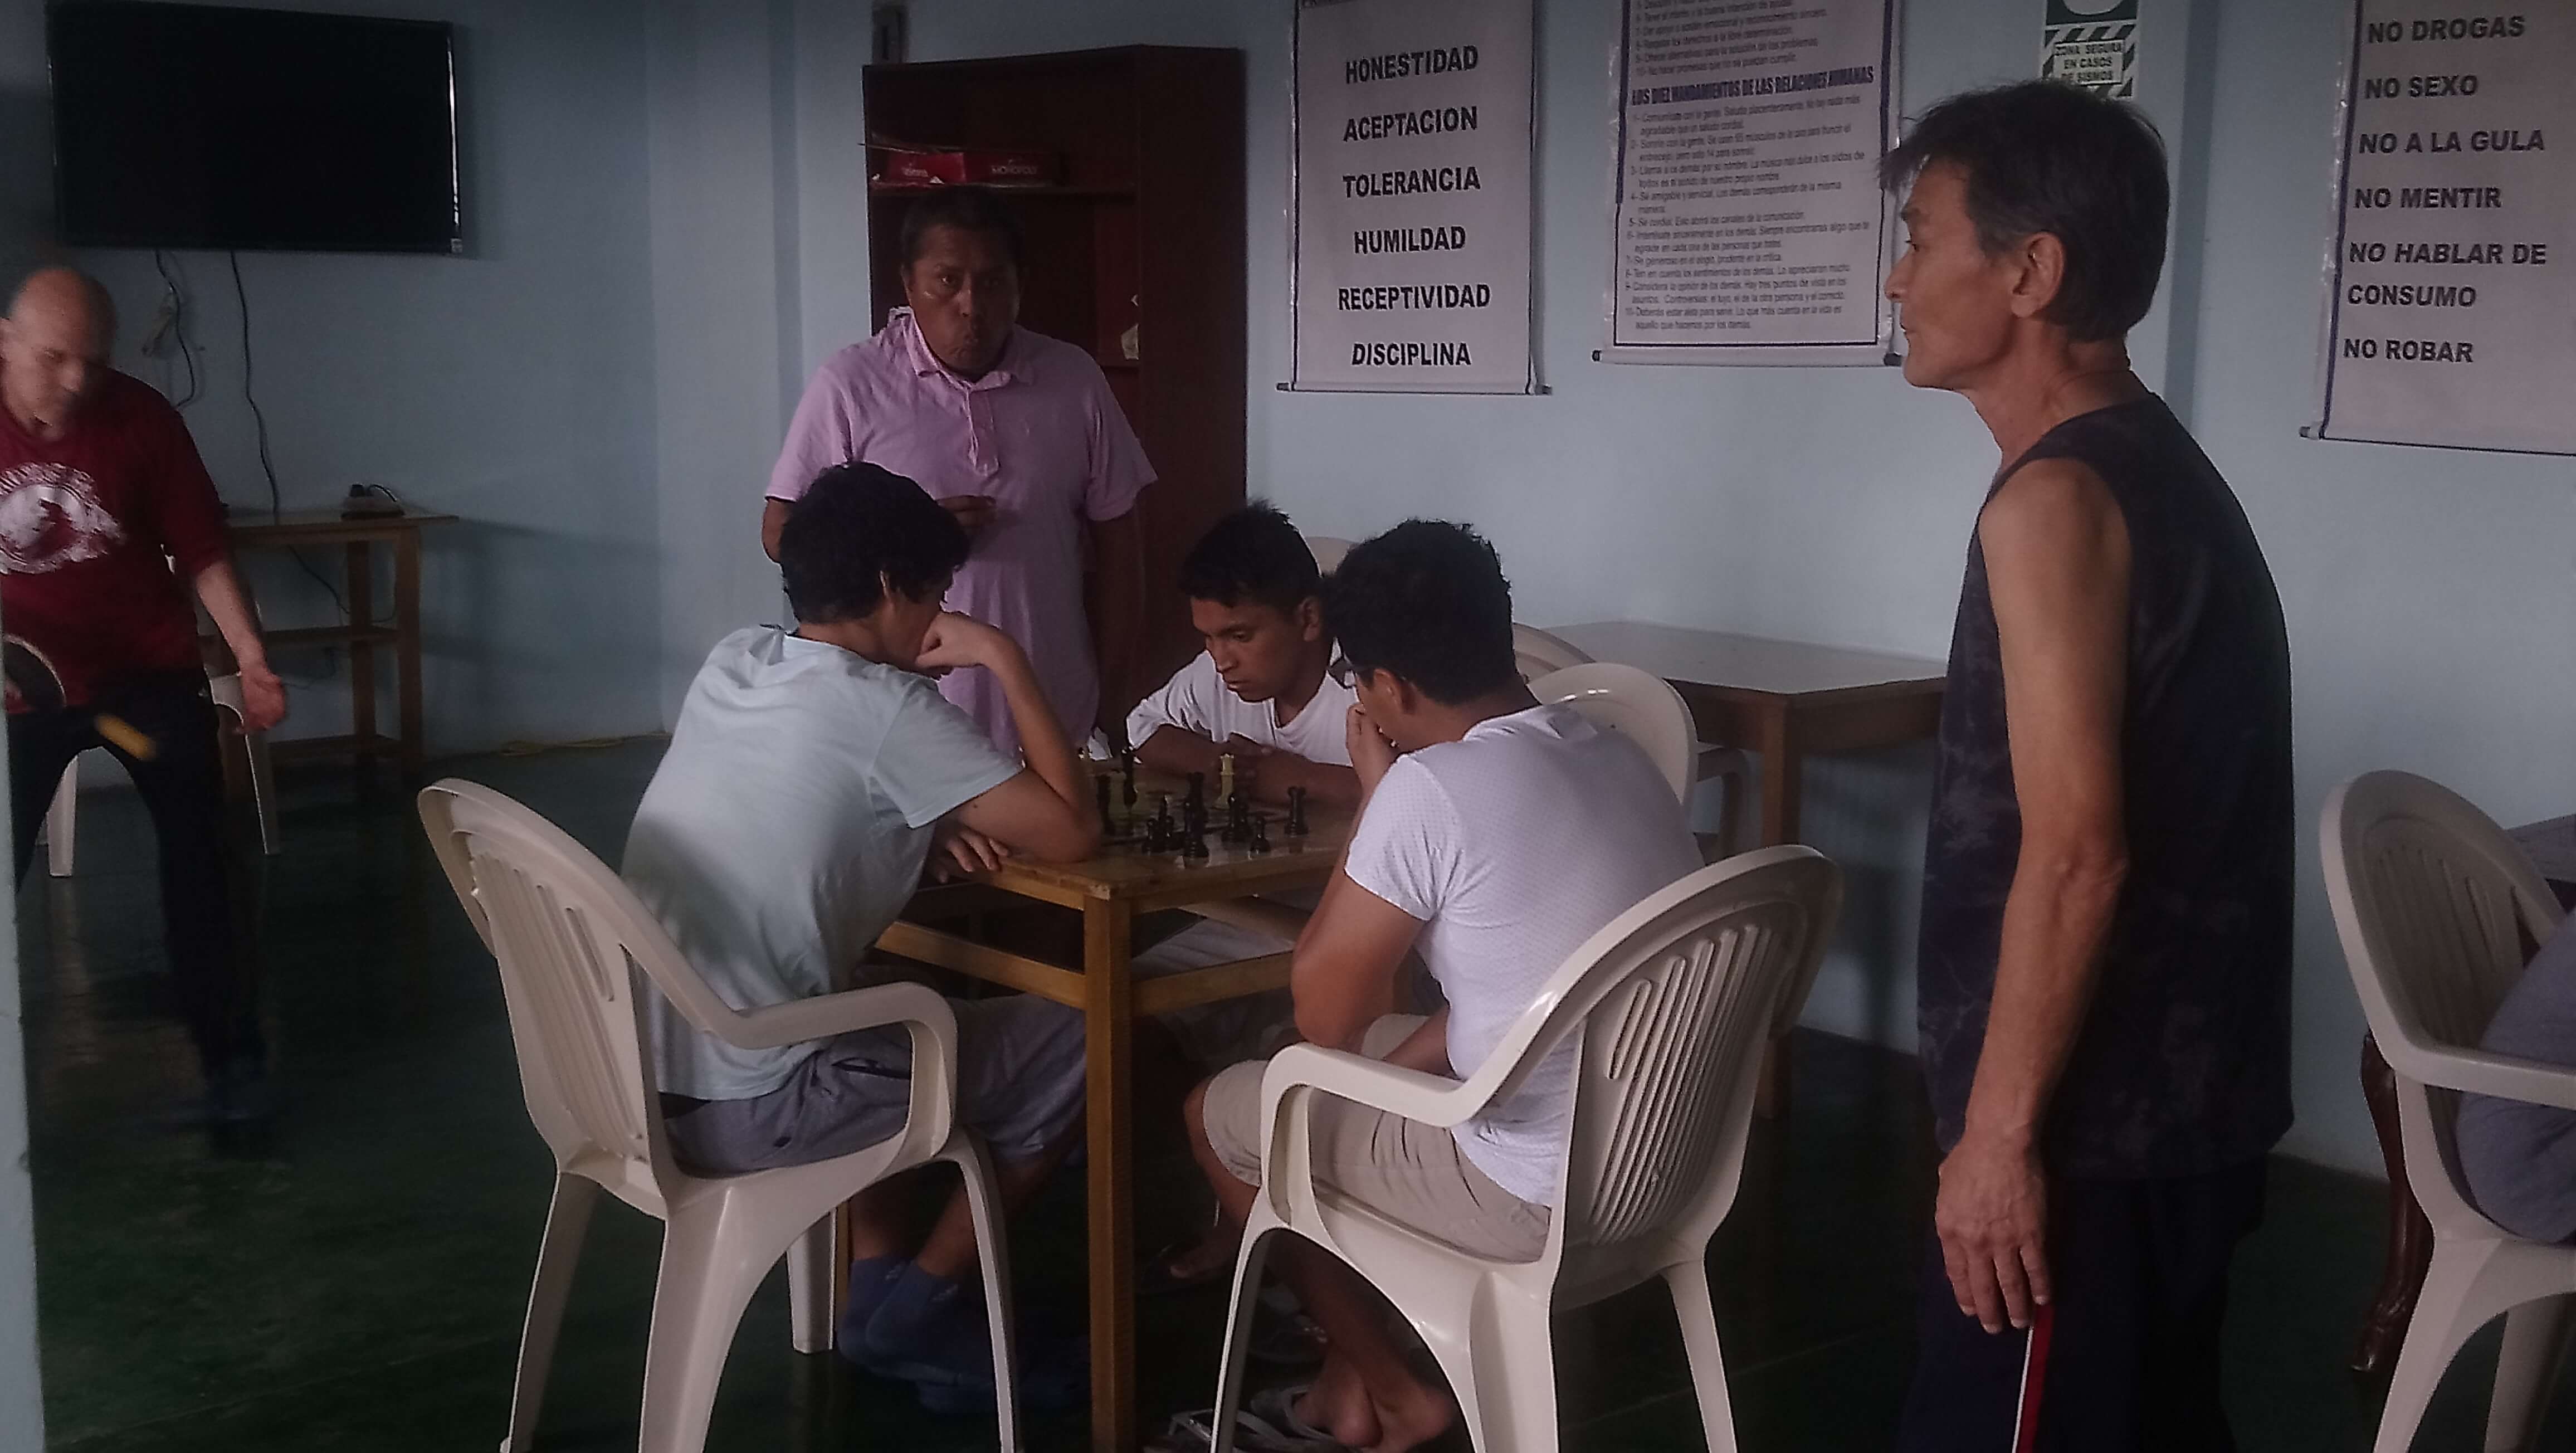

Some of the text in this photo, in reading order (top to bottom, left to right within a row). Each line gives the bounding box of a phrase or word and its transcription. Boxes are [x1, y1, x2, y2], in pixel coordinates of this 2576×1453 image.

[2368, 15, 2525, 43] NO DROGAS
[1345, 45, 1479, 85] HONESTIDAD
[2064, 57, 2112, 69] EN CASOS
[1755, 77, 1773, 95] LAS
[2365, 75, 2478, 99] NO SEXO
[1343, 106, 1477, 142] ACEPTACION
[2359, 129, 2545, 154] NO A LA GULA
[1342, 166, 1481, 198] TOLERANCIA
[2355, 187, 2501, 209] NO MENTIR
[1354, 226, 1466, 255] HUMILDAD
[2349, 242, 2546, 265] NO HABLAR DE
[1338, 284, 1490, 310] RECEPTIVIDAD
[2348, 284, 2476, 307] CONSUMO
[1352, 343, 1471, 366] DISCIPLINA
[2343, 338, 2473, 363] NO ROBAR
